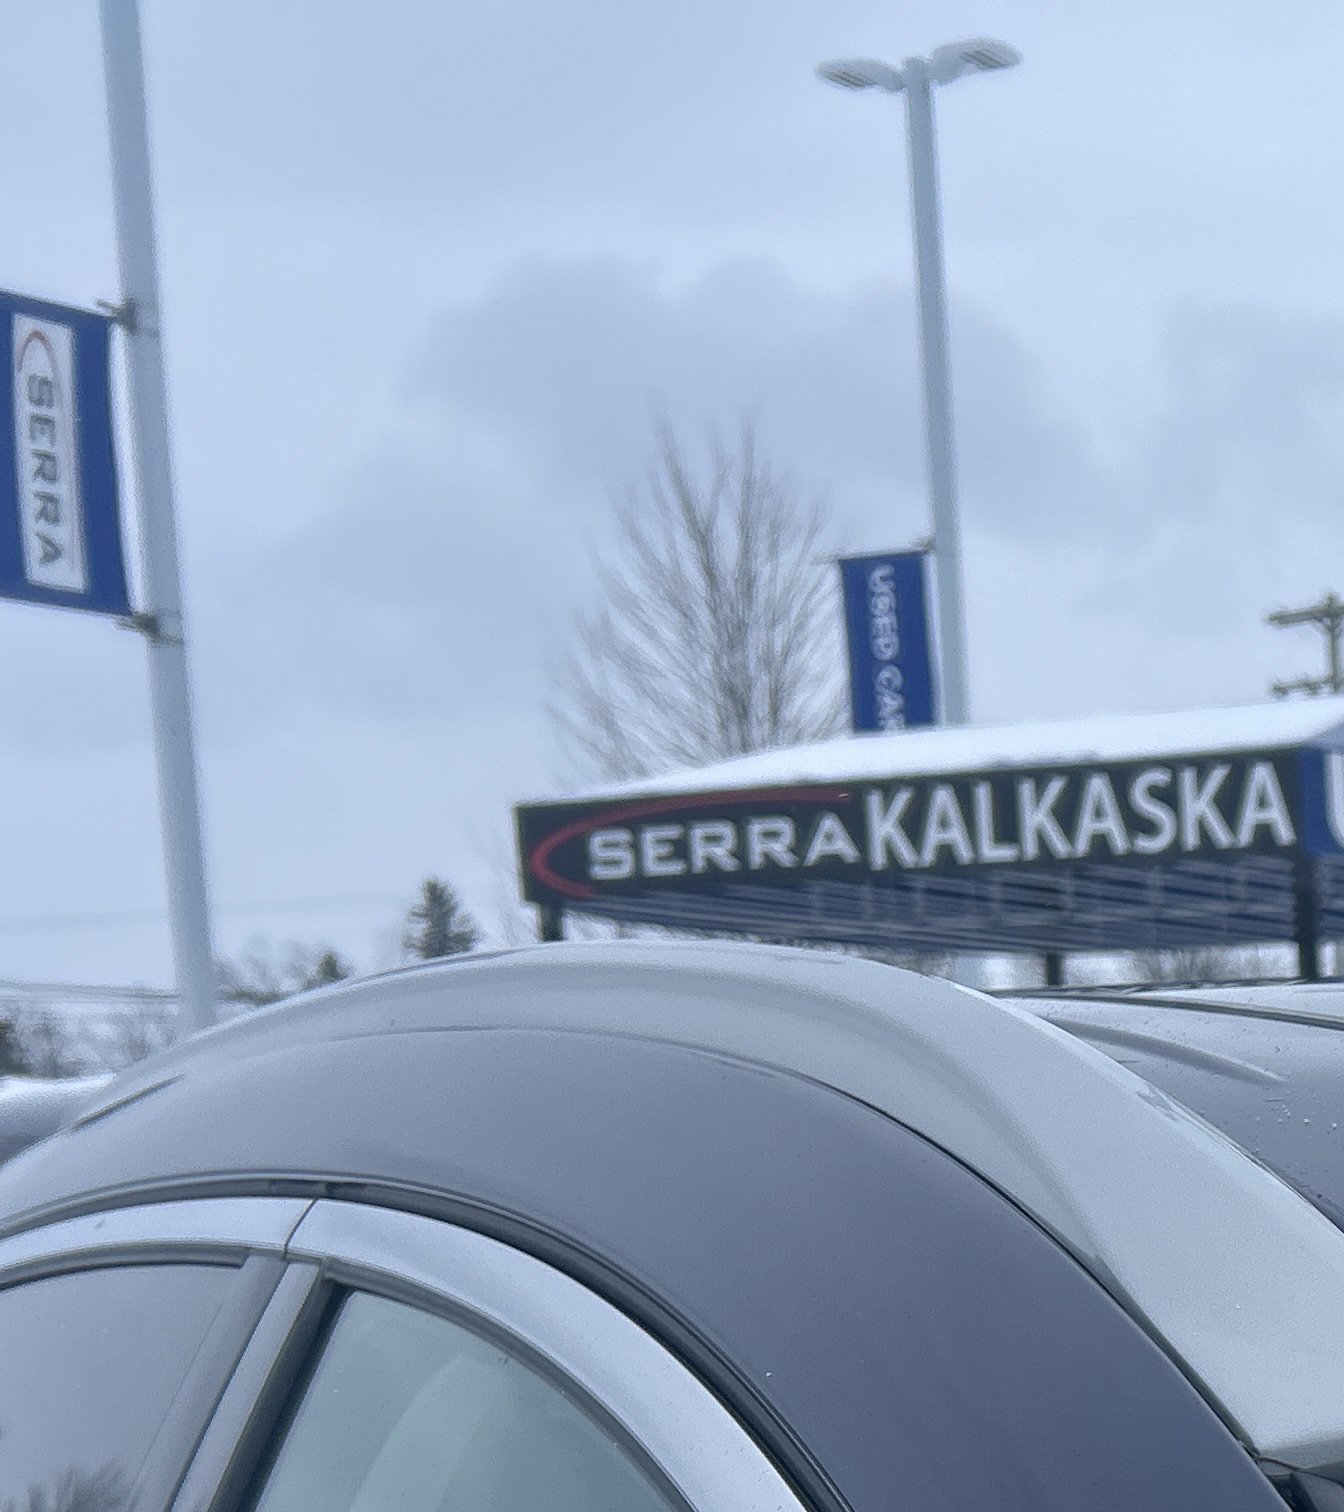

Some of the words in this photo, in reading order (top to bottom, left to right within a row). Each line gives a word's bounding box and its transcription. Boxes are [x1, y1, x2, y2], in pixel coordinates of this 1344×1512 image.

[28, 373, 63, 567] SERRA
[587, 811, 861, 881] SERRA
[866, 760, 1298, 872] KALKASKA
